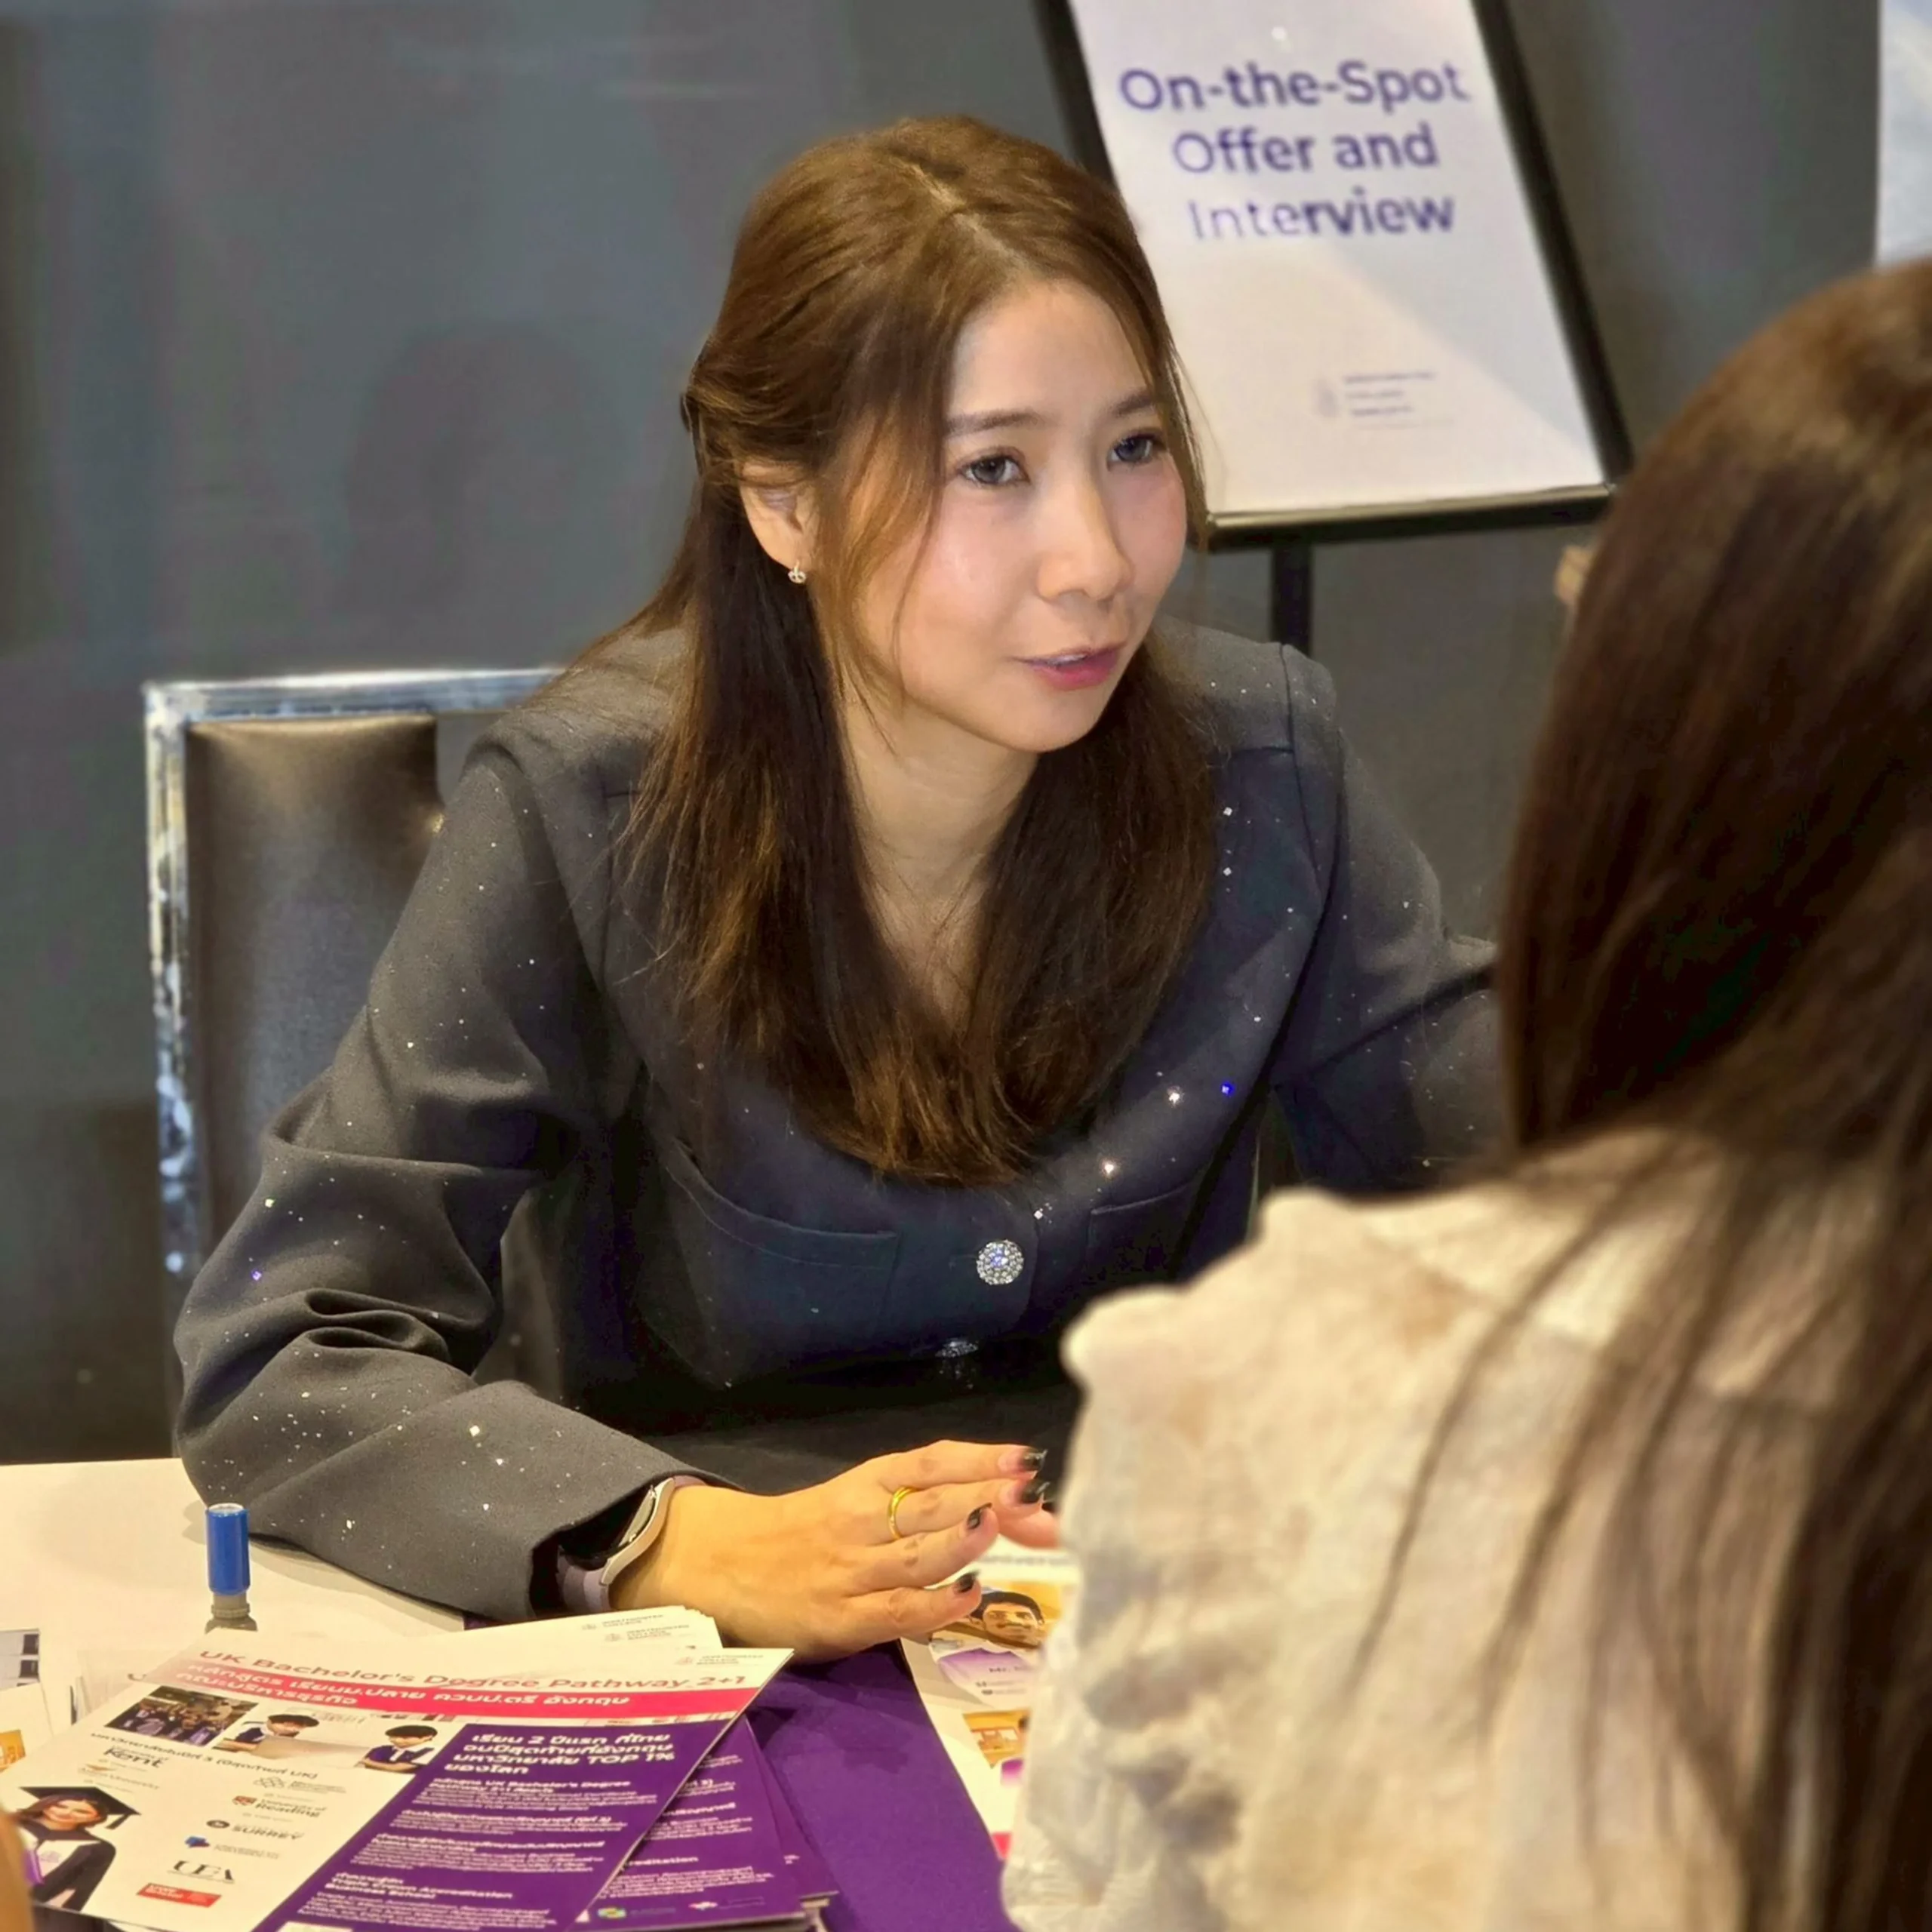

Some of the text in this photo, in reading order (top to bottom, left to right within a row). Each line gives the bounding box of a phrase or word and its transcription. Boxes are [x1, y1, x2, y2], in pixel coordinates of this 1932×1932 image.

[1119, 61, 1471, 113] On-the-Spot
[1173, 123, 1438, 173] Offer and
[1190, 186, 1455, 240] Interview
[200, 1651, 246, 1663] UK
[252, 1659, 415, 1683] Bachelor's
[549, 1678, 690, 1689] Pathway
[697, 1676, 746, 1686] 2+1
[103, 1747, 165, 1768] Kent
[528, 1736, 545, 1745] 2
[587, 1754, 640, 1764] TOP
